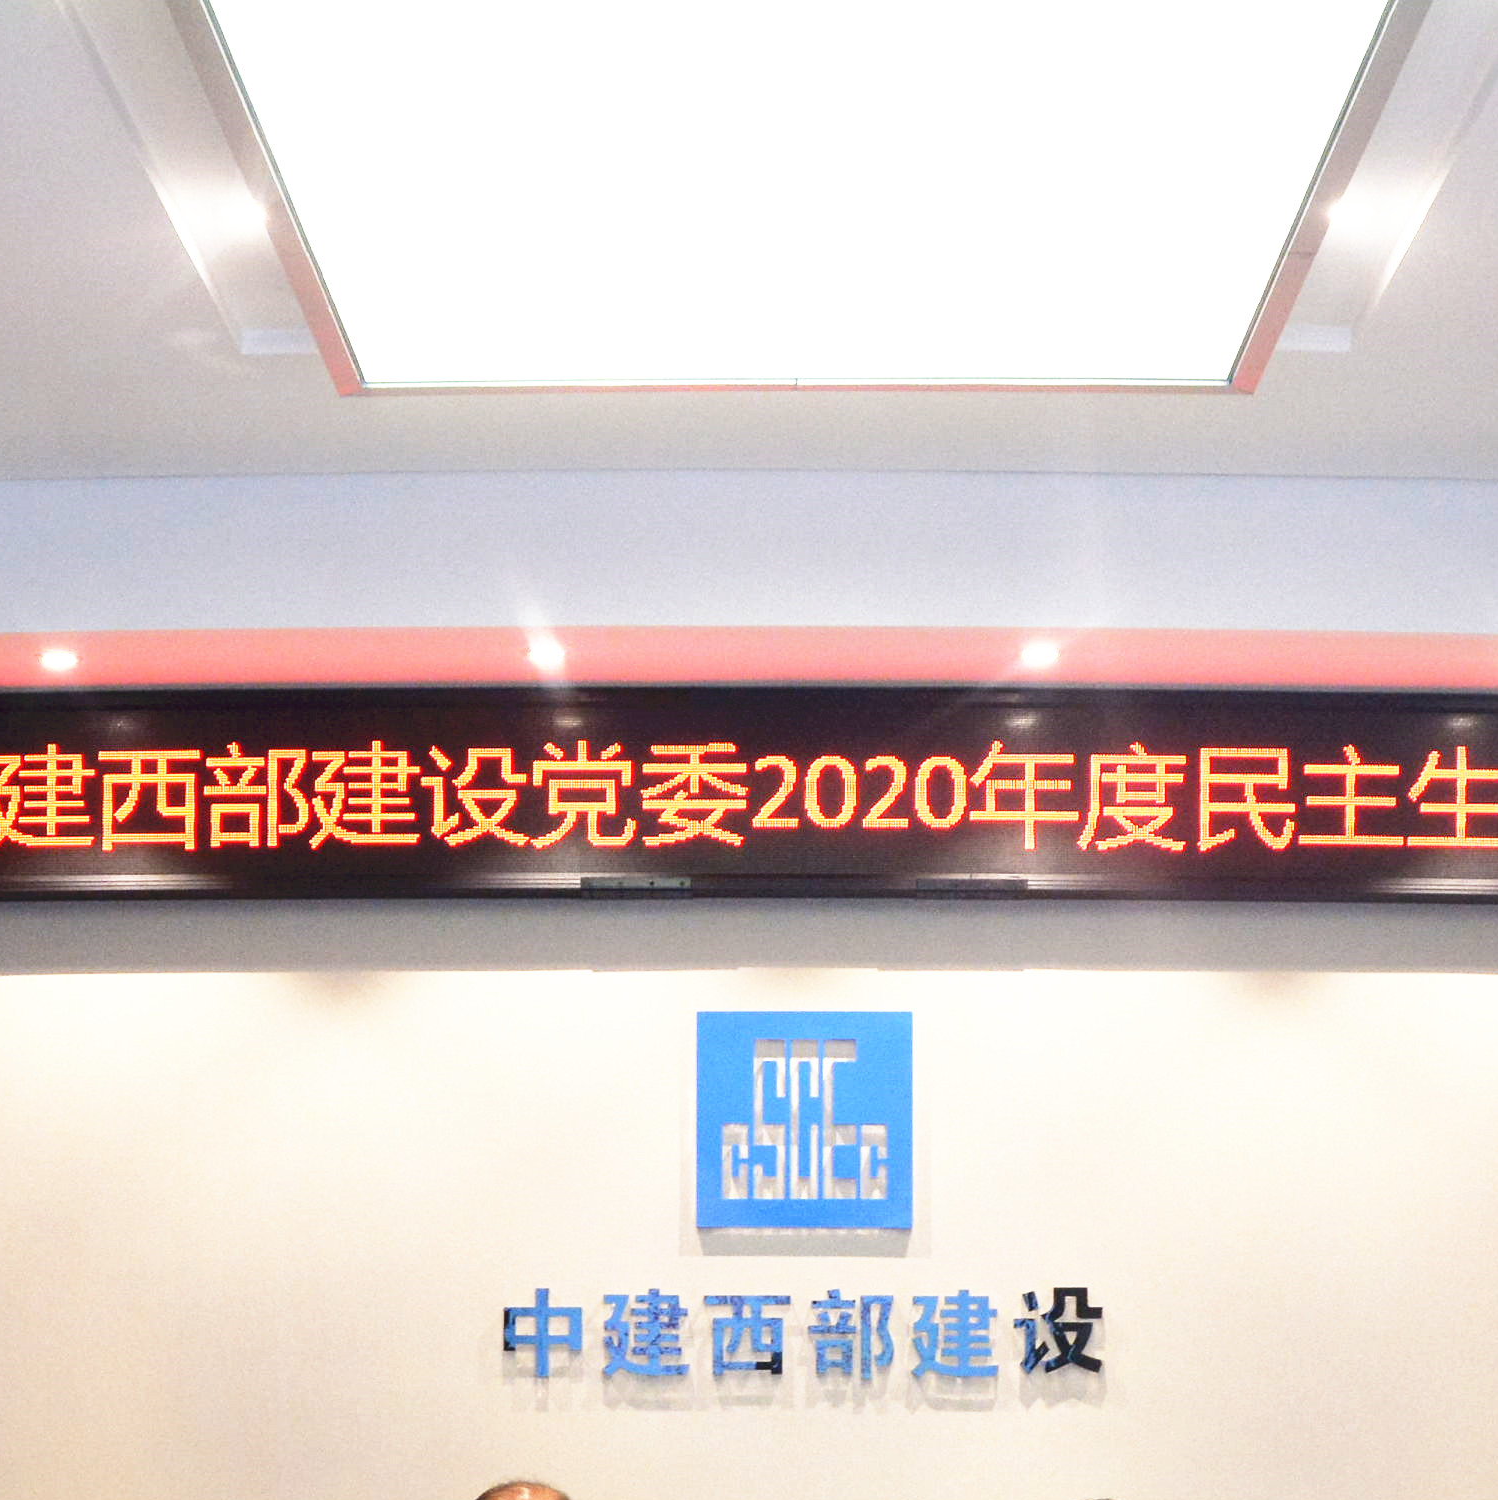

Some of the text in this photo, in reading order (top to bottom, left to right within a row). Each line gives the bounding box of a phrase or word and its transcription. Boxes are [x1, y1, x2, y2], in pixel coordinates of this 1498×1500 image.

[503, 1286, 1103, 1380] 中建西部建设
